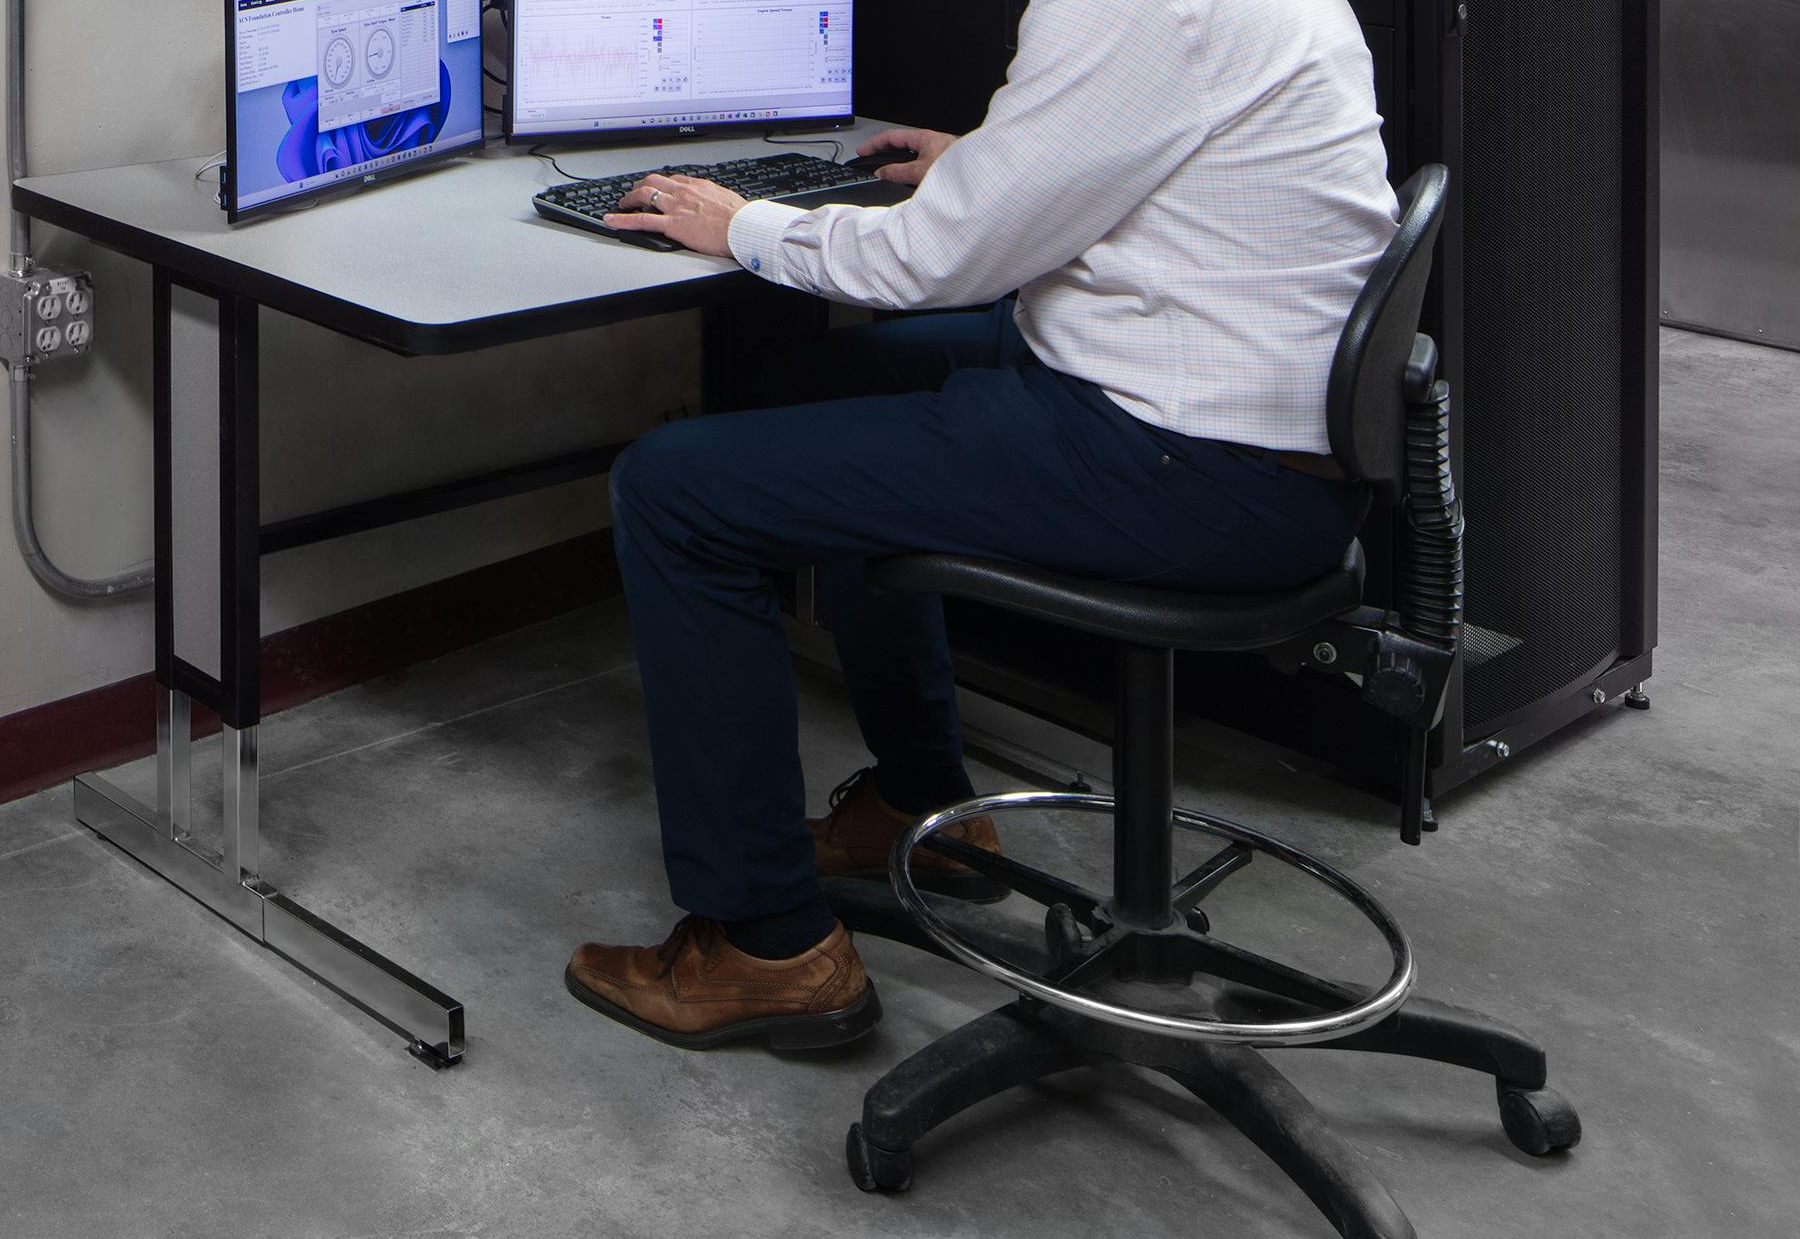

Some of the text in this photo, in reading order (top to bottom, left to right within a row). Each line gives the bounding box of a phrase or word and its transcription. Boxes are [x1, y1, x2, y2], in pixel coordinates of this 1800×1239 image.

[248, 12, 272, 22] Foundation
[271, 8, 293, 17] Controller
[679, 125, 696, 133] DELL
[363, 173, 376, 183] DELL
